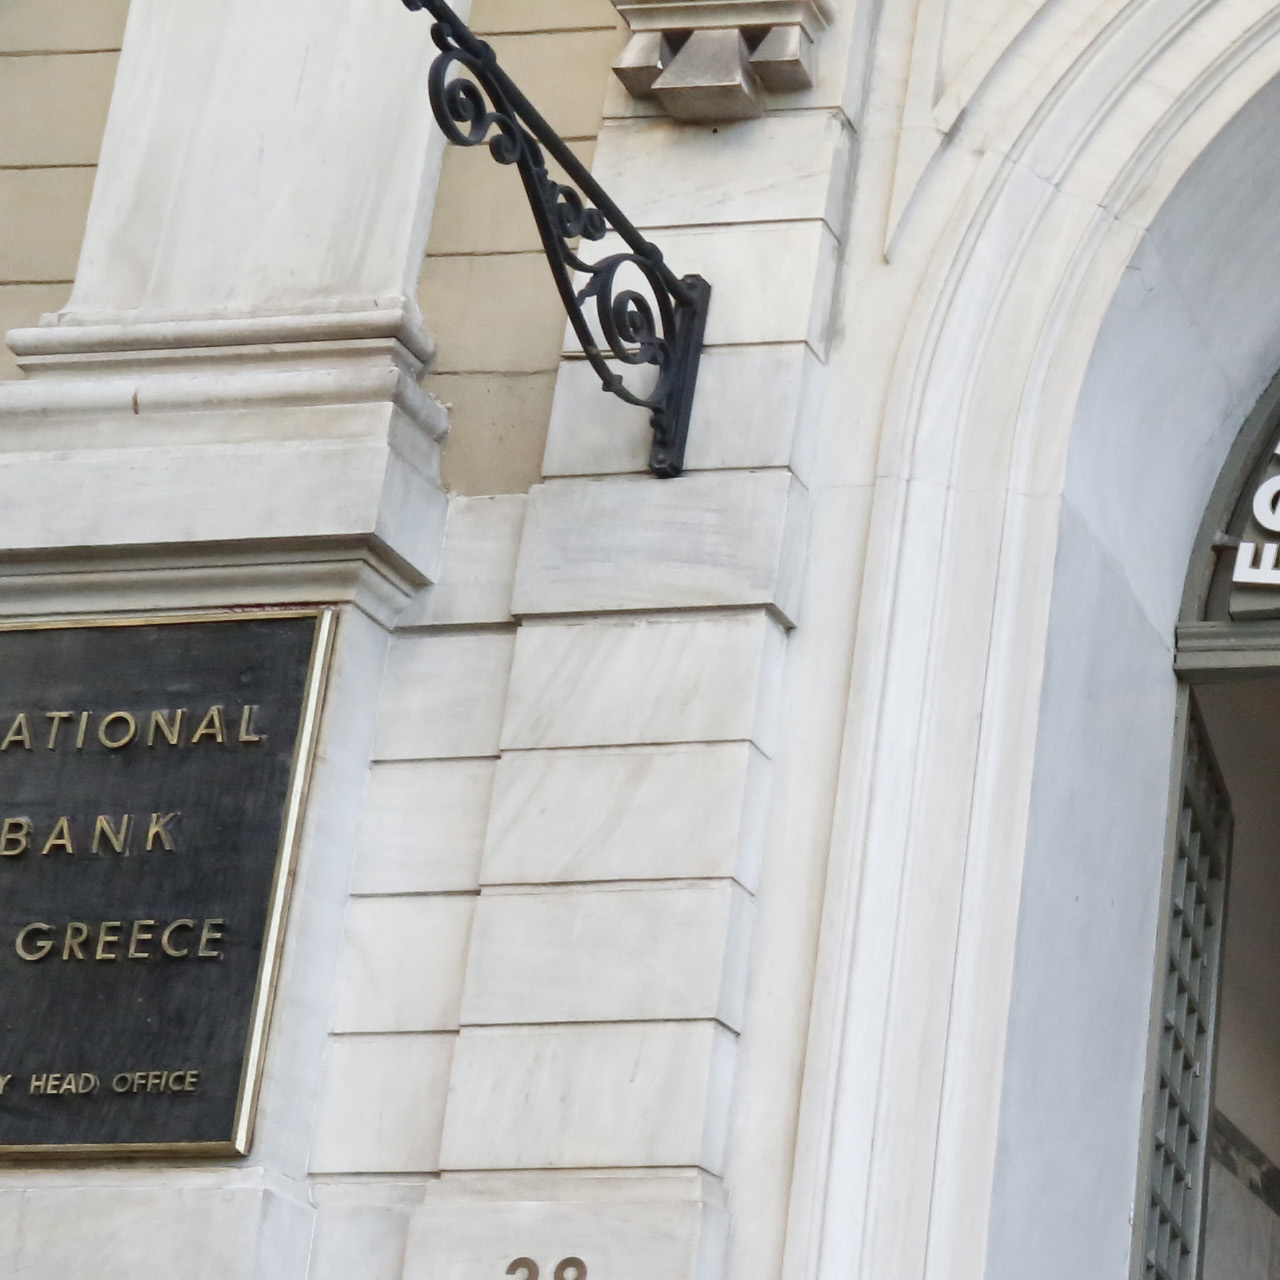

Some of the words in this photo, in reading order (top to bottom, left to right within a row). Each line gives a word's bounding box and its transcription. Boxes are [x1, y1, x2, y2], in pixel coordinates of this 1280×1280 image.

[0, 812, 180, 856] BANK
[15, 918, 225, 961] GREECE
[29, 1072, 96, 1095] HEAD
[111, 1070, 199, 1093] OFFICE
